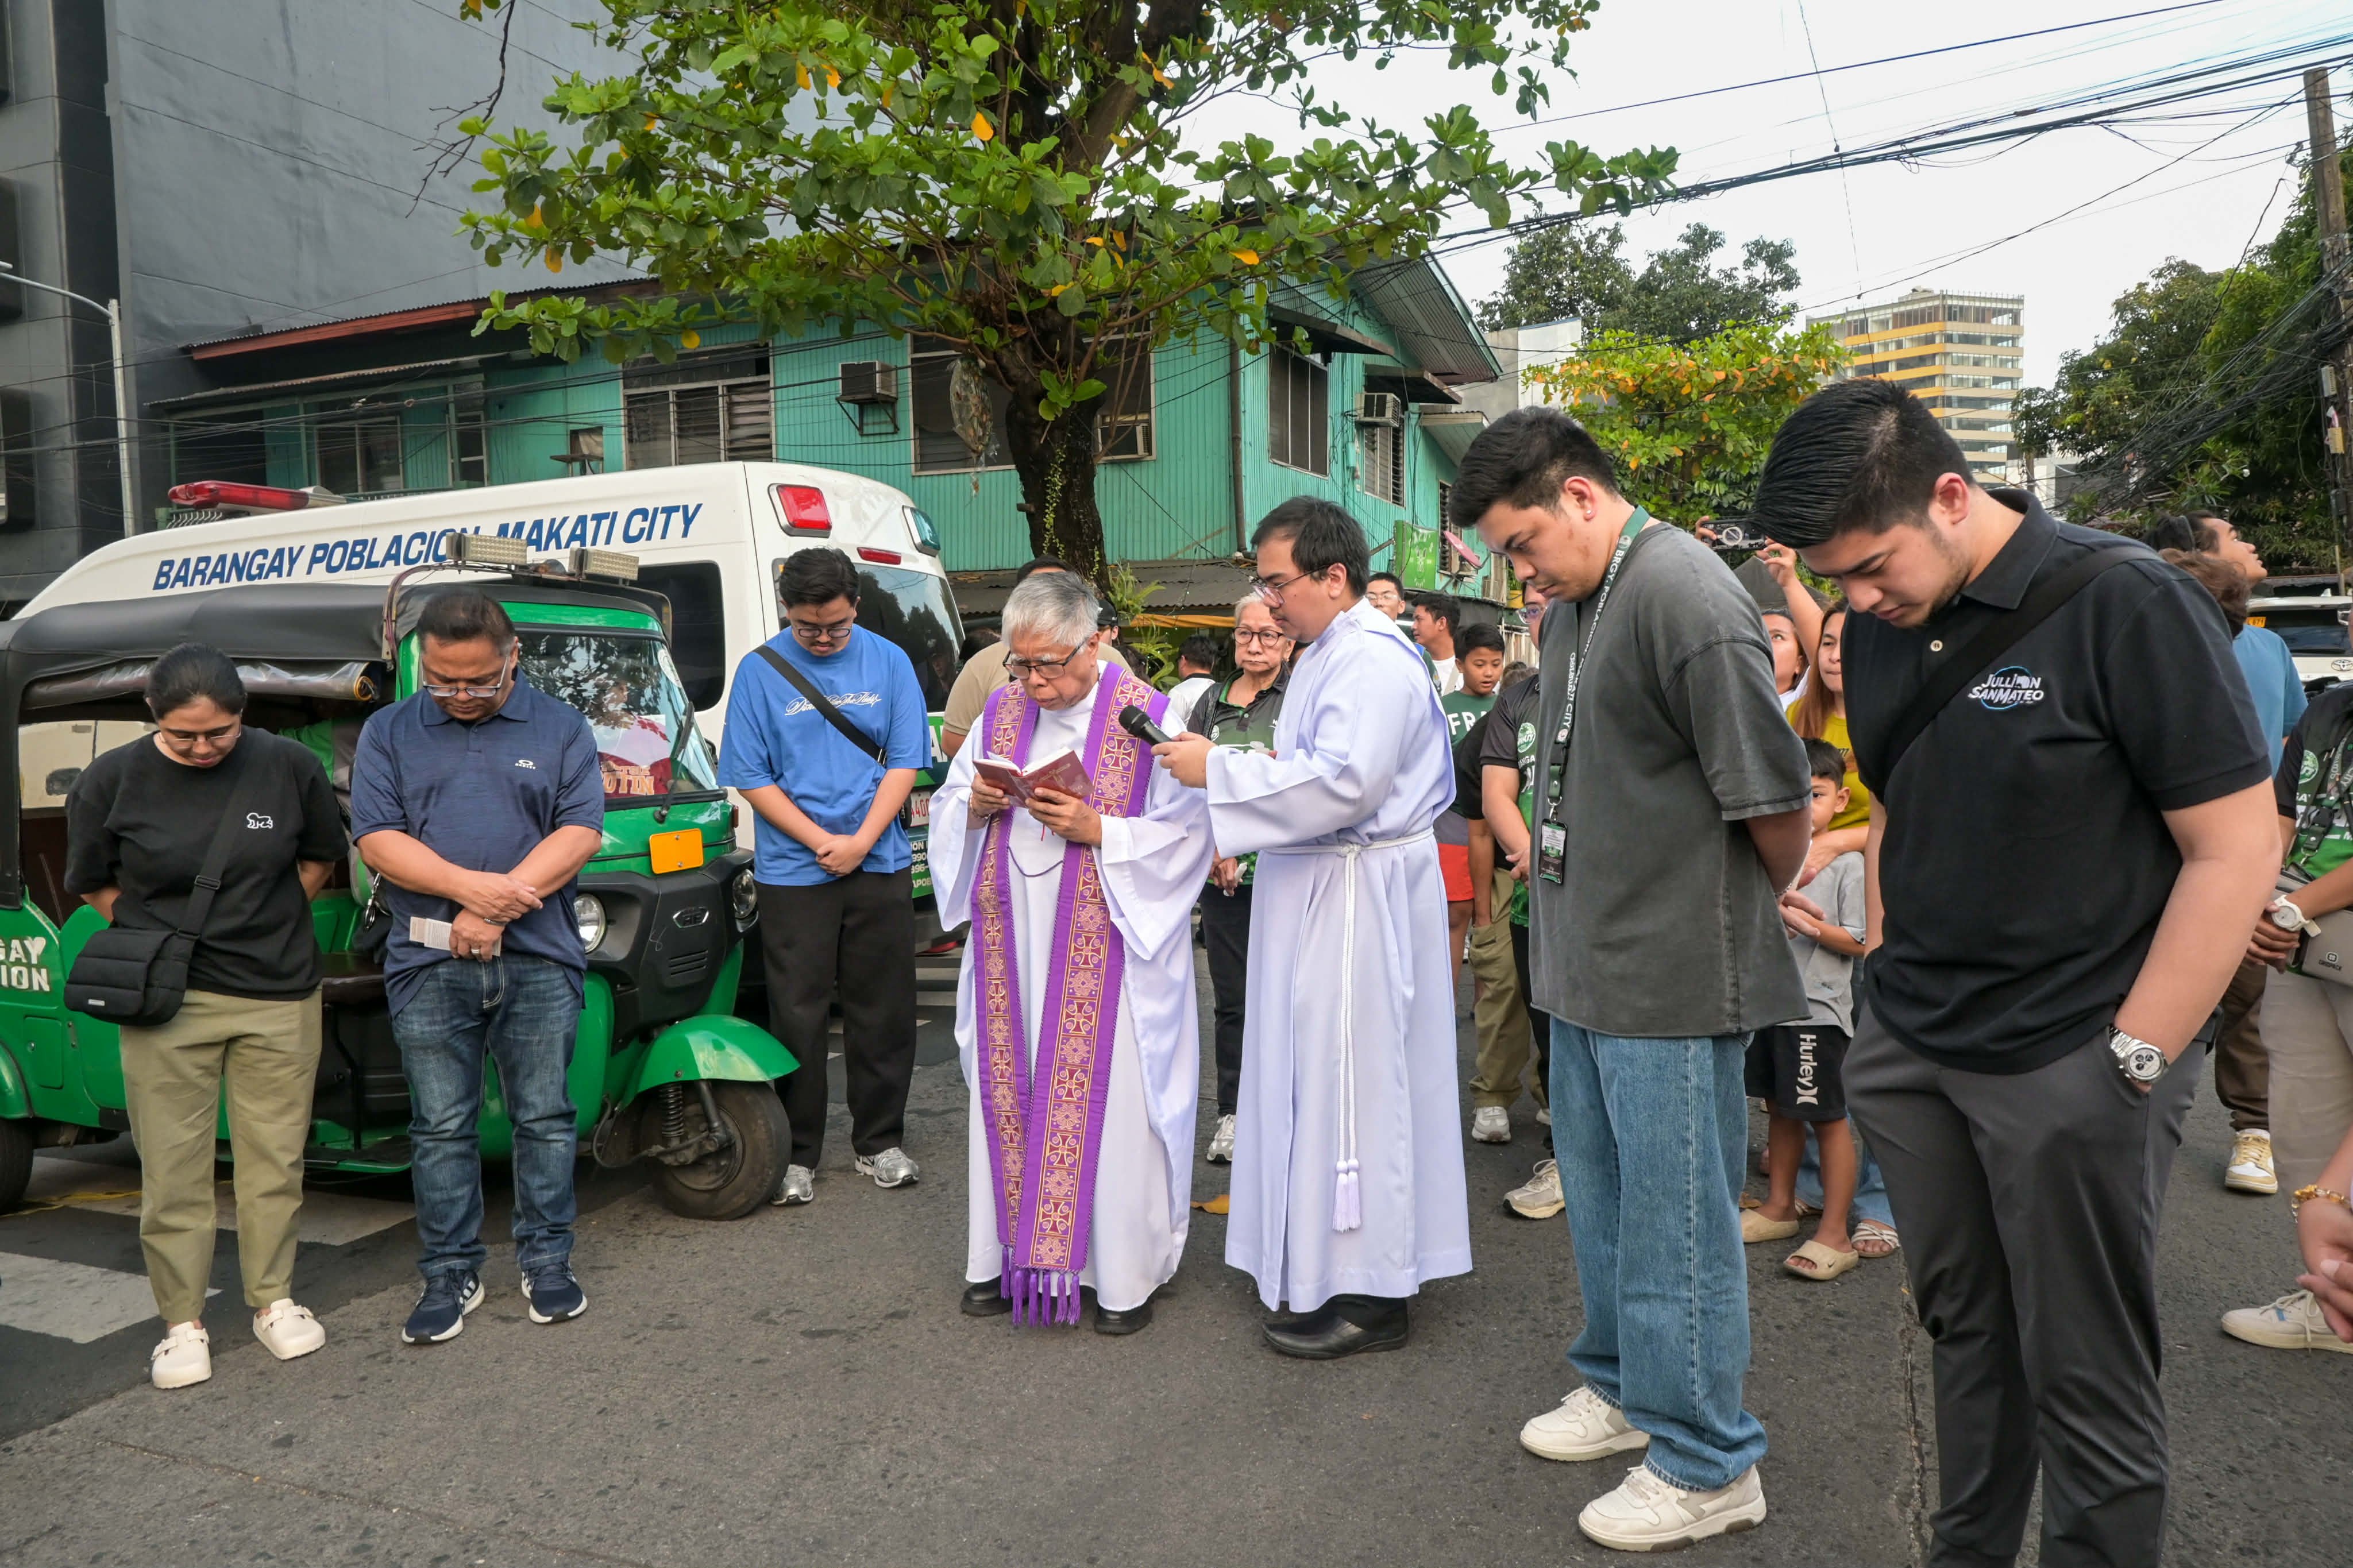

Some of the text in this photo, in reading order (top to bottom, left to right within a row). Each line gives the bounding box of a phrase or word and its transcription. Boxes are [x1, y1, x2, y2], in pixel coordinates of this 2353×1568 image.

[153, 545, 306, 590] BARANGAY
[306, 526, 480, 575] POBLACIO
[623, 503, 703, 543] CITY
[1563, 704, 1573, 728] CITY
[1797, 1034, 1818, 1087] Hurley
